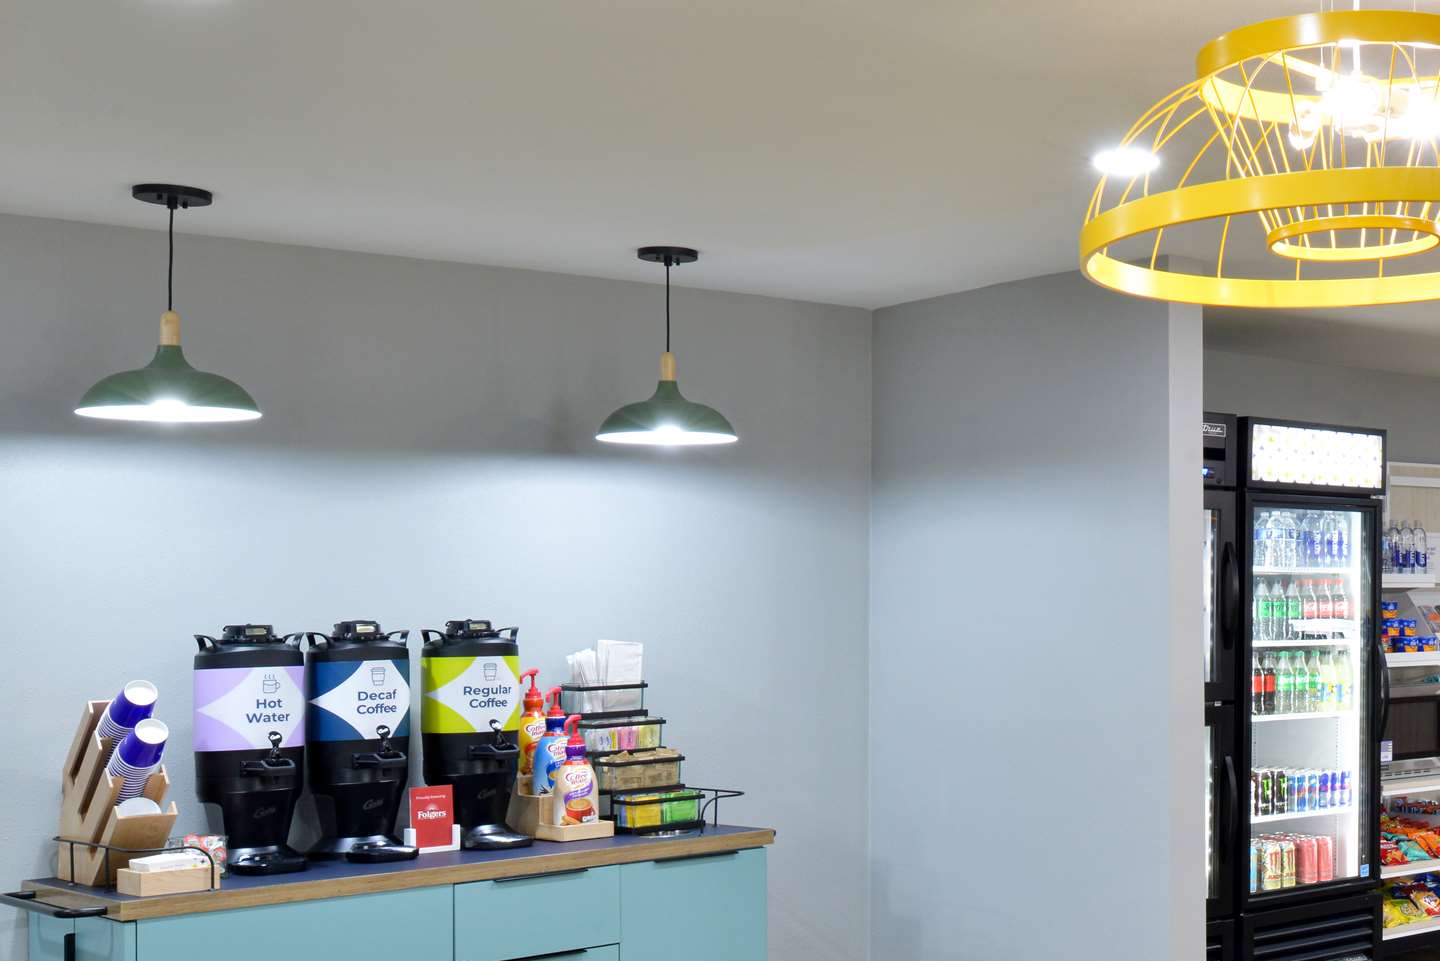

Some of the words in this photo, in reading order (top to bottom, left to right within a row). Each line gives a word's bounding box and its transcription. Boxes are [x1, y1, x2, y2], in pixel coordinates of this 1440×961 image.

[357, 689, 397, 702] Decaf
[463, 684, 512, 698] Regular
[256, 698, 283, 709] Hot
[356, 703, 397, 715] Coffee
[469, 698, 508, 709] Coffee
[246, 712, 291, 724] Water
[417, 810, 447, 821] Folgers
